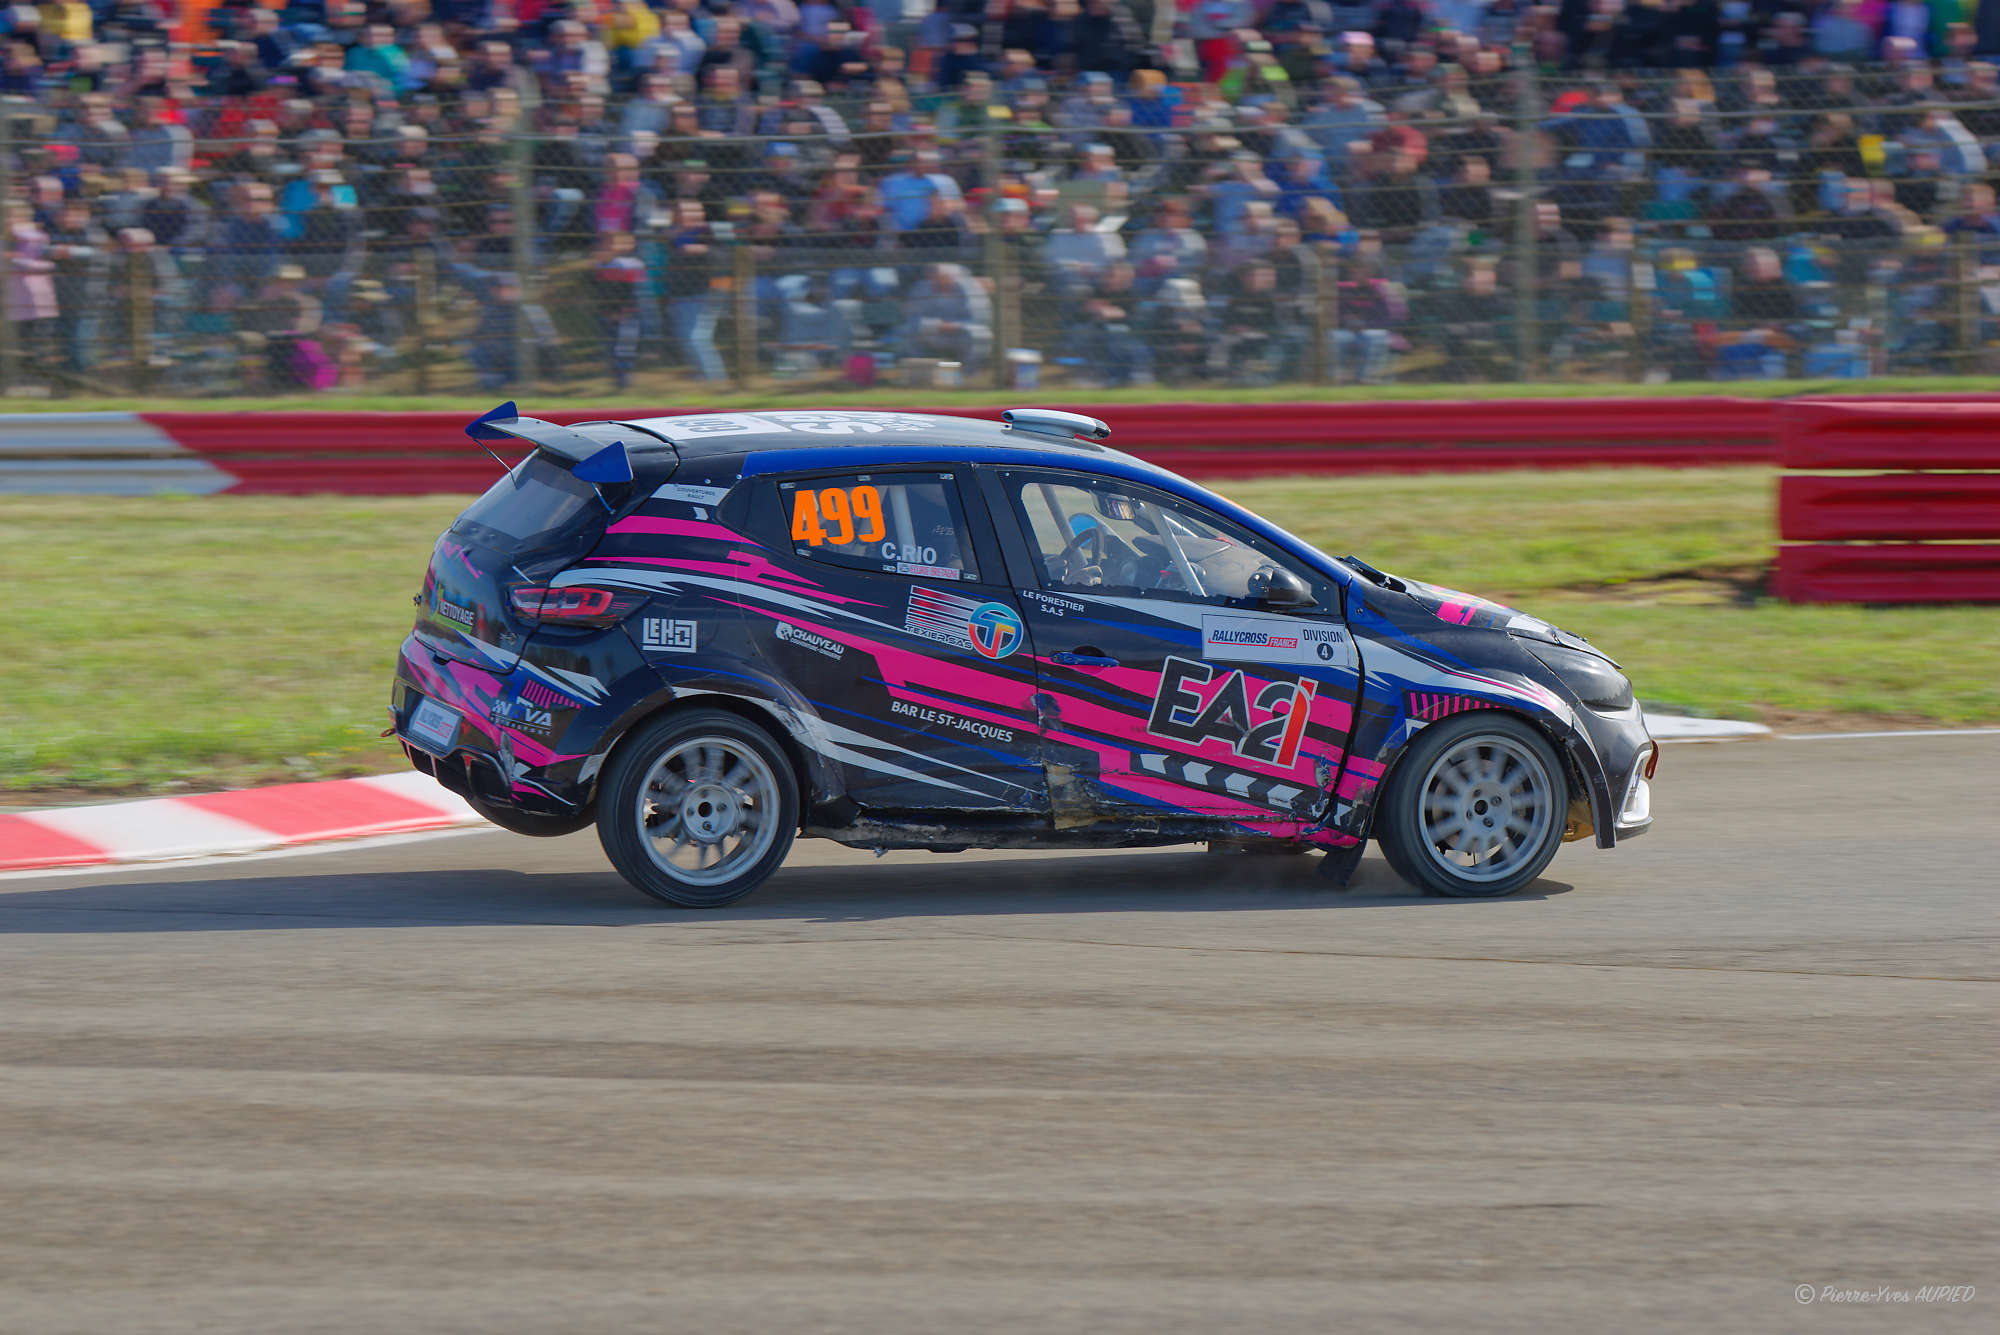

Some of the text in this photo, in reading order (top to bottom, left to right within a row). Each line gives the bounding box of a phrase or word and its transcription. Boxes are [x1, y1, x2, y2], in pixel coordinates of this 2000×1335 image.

[792, 485, 886, 546] 499
[881, 542, 937, 565] C.RIO
[439, 600, 474, 626] NETTOYAGE
[1023, 590, 1085, 613] LE FORESTIER
[793, 628, 845, 655] CHAUVEAU
[1212, 630, 1298, 648] RALLYCROSS FRANCE
[1303, 629, 1344, 643] DIVISION
[1321, 645, 1329, 659] 4
[891, 700, 1014, 743] BAR LE ST-JACQUES
